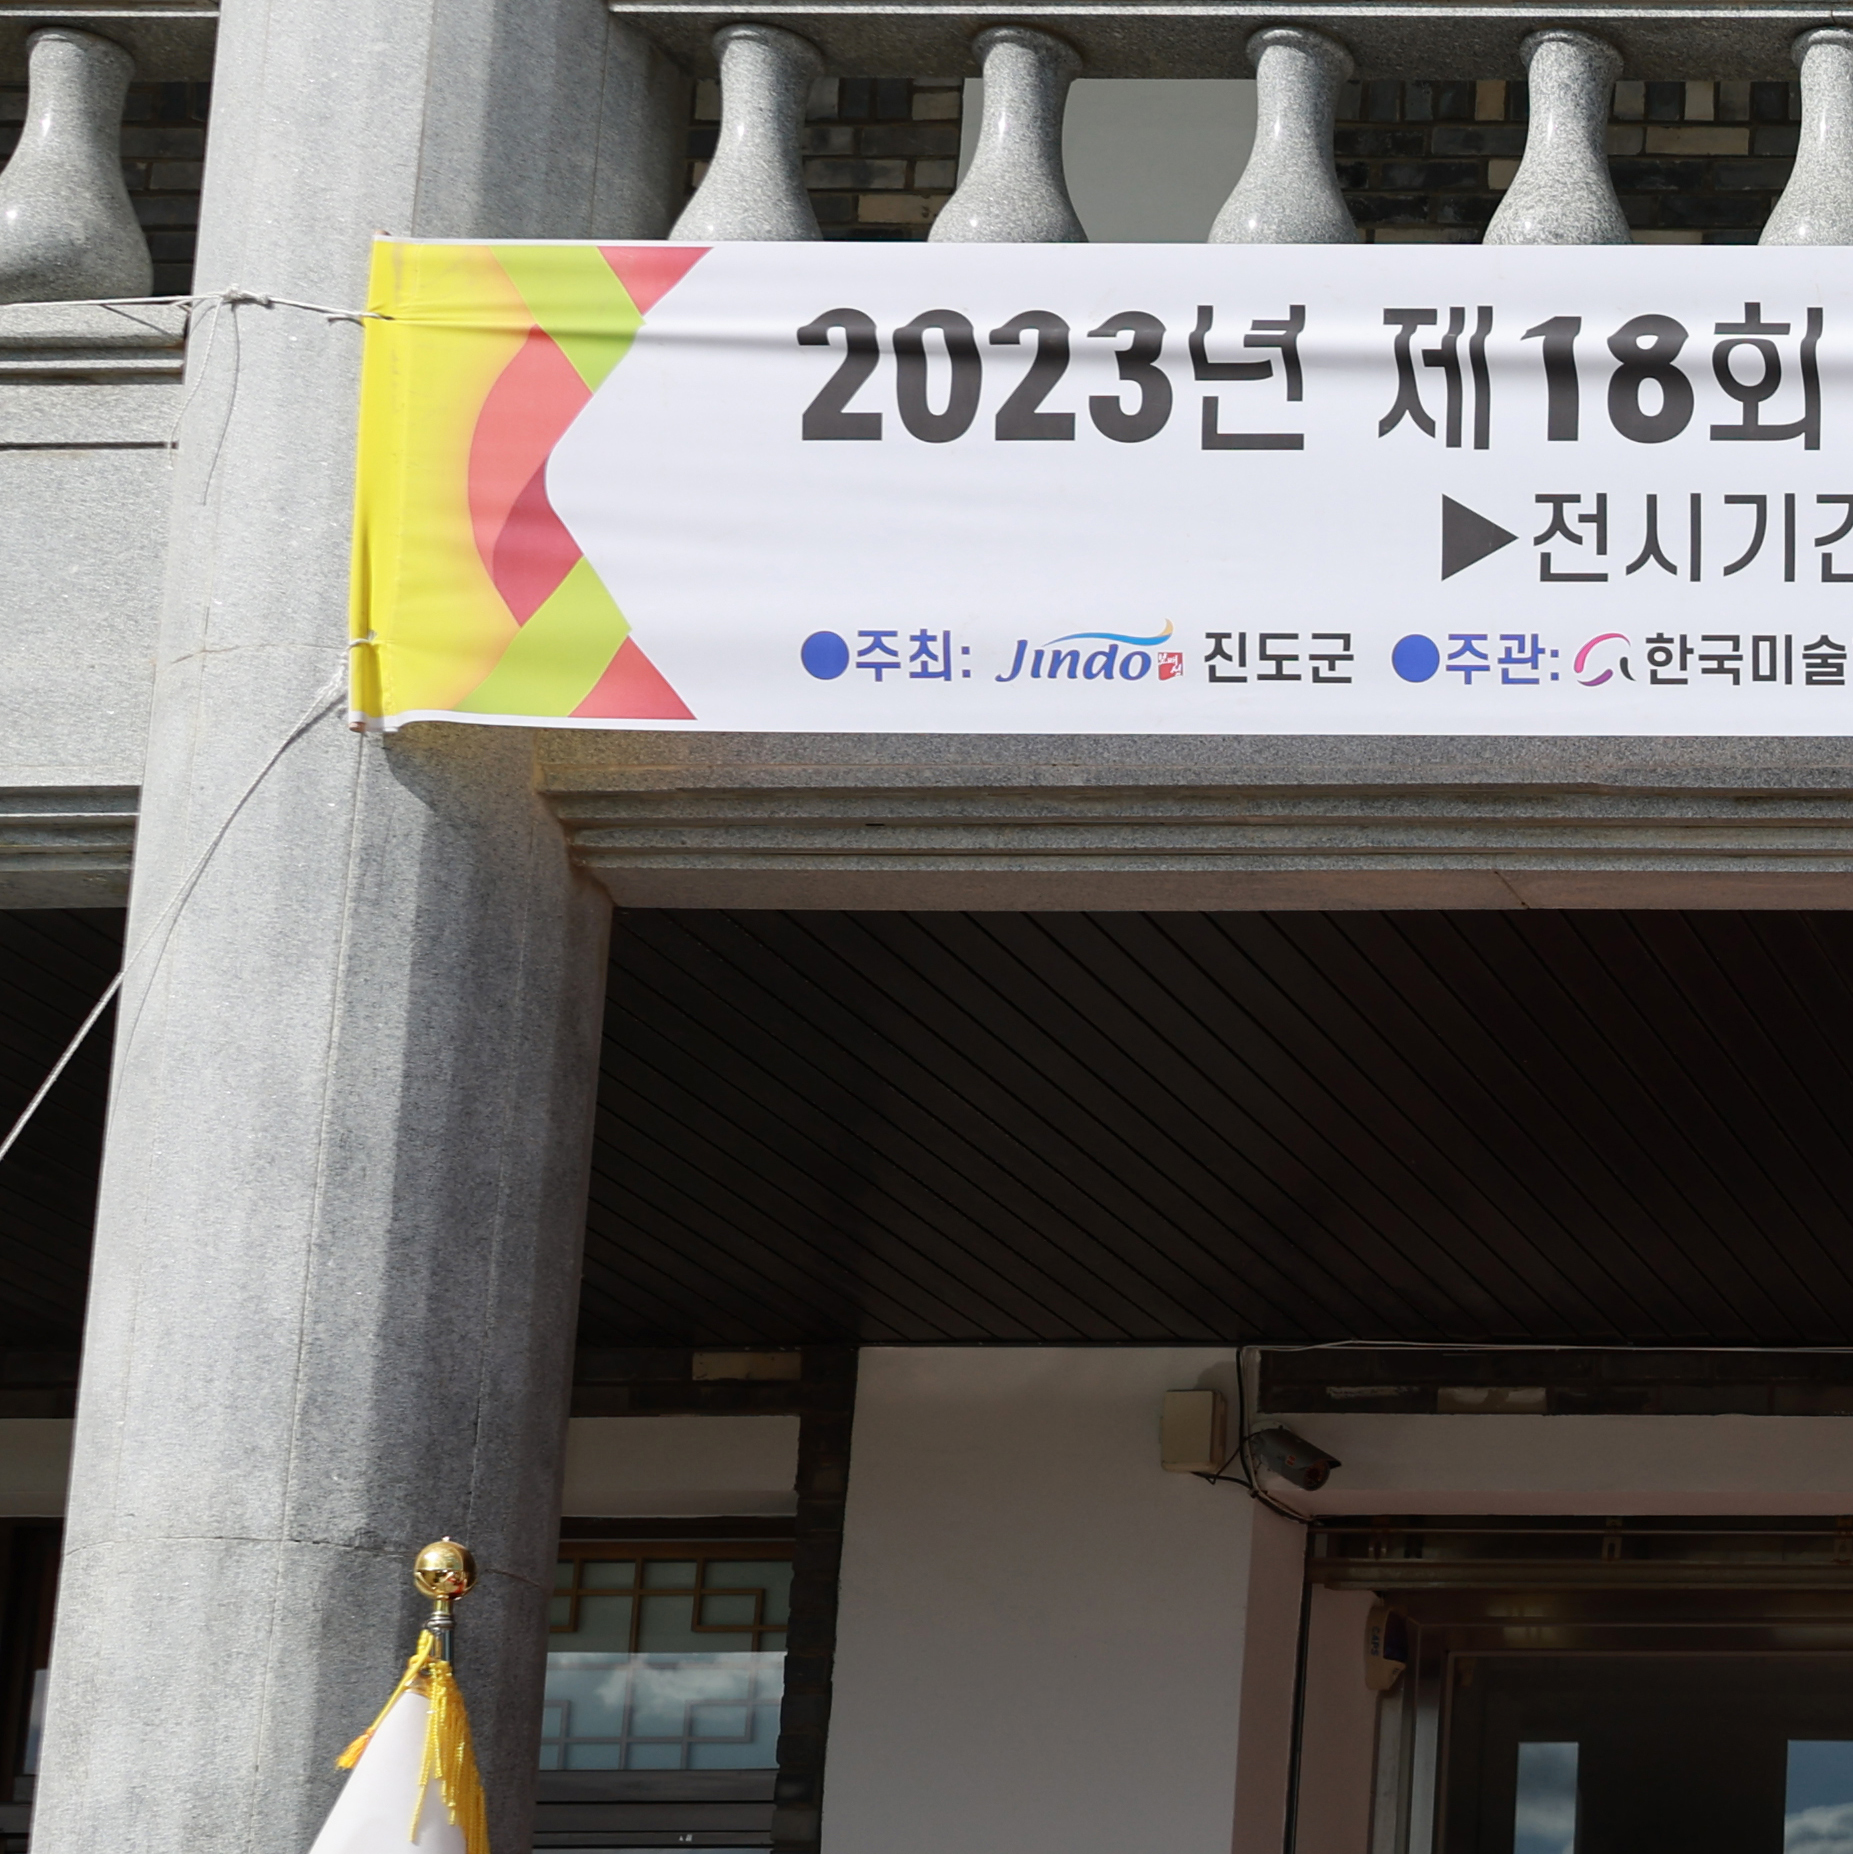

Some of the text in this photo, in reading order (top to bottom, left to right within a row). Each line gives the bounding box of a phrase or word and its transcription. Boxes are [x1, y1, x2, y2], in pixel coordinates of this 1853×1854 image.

[796, 303, 1306, 452] 2023년
[1378, 302, 1824, 452] 제18회
[853, 630, 971, 682] 주최:
[994, 638, 1152, 683] Jindo
[1204, 632, 1355, 685] 진도군
[1446, 632, 1559, 685] 주관:
